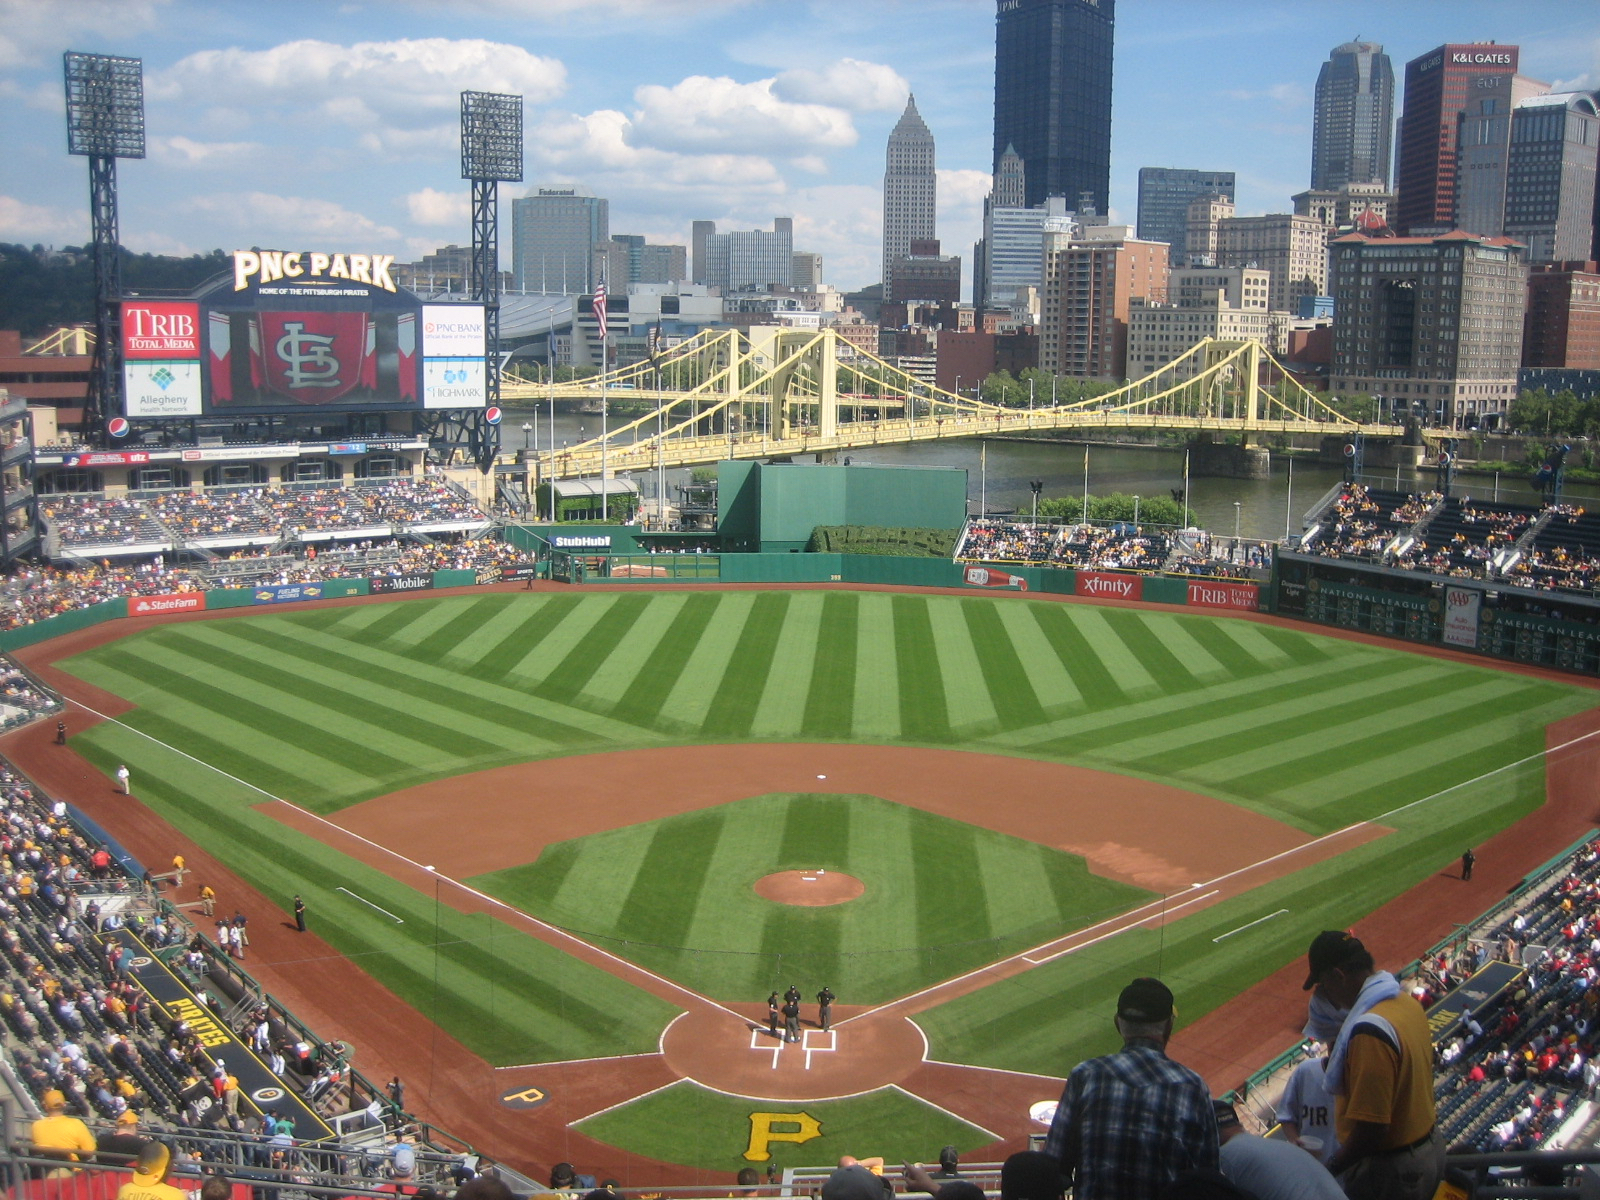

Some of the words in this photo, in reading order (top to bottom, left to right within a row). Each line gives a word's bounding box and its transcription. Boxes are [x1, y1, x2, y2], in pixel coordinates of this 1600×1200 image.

[1453, 54, 1472, 63] K&L
[1475, 54, 1510, 63] GATES
[233, 250, 304, 292] PNC
[310, 252, 397, 293] PARK
[127, 309, 194, 336] TRIB
[436, 324, 457, 332] PNC
[458, 324, 483, 332] BANK
[129, 338, 162, 349] TOTAL
[164, 339, 195, 349] MEDIA
[140, 395, 188, 406] Allegheny
[475, 567, 502, 585] PIRATES
[1084, 576, 1132, 596] xfinity
[1230, 588, 1255, 599] TOTAL
[1286, 588, 1300, 597] Light
[1188, 585, 1227, 604] TRIB
[1231, 596, 1256, 607] MEDIA
[1320, 587, 1376, 603] NATIONAL
[1381, 598, 1426, 611] LEAGUE
[1449, 592, 1469, 606] AAA
[1496, 618, 1565, 635] AMERICAN
[1447, 634, 1475, 644] AAA.com
[165, 997, 232, 1048] PIRATES
[741, 1111, 823, 1162] P
